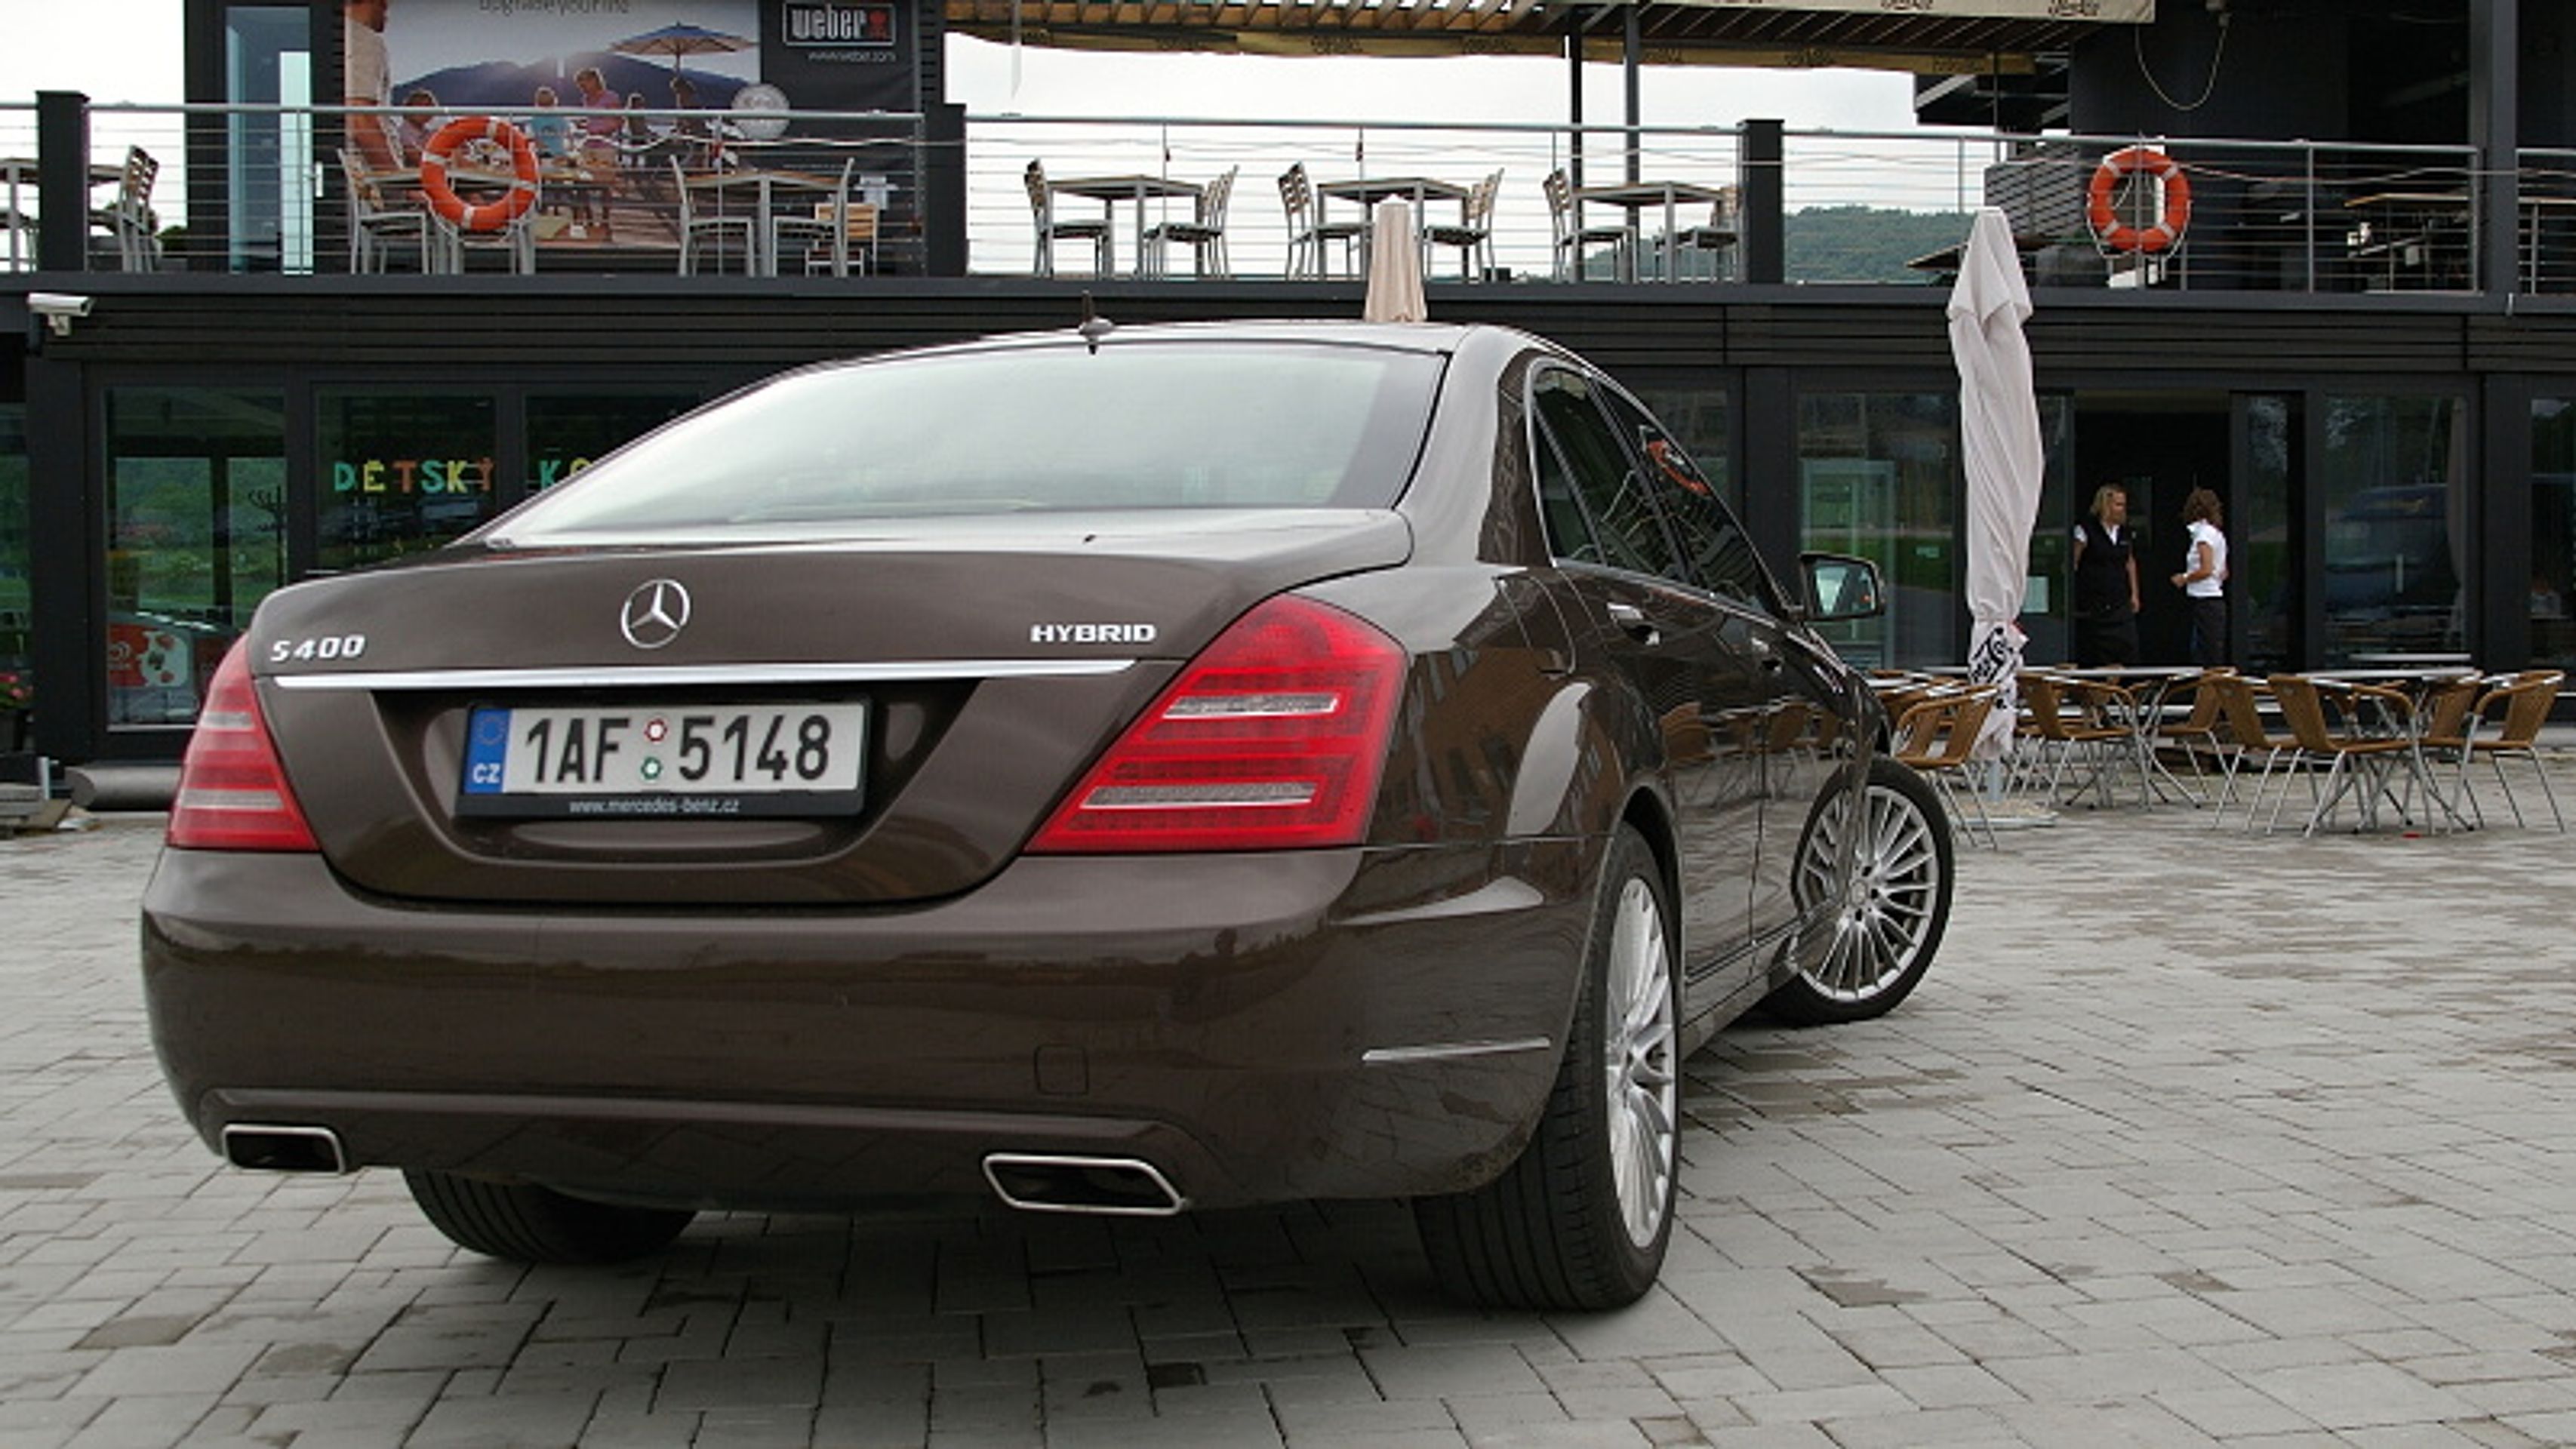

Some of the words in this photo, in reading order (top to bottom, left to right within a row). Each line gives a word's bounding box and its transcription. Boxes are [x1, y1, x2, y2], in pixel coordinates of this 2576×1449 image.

[792, 4, 866, 39] weber
[1029, 623, 1157, 642] HYBRID
[269, 634, 366, 662] S400
[526, 717, 630, 783] 1AF
[679, 714, 831, 782] 5148
[472, 764, 501, 784] CZ
[569, 797, 739, 814] www.mercedes-benz.cz
